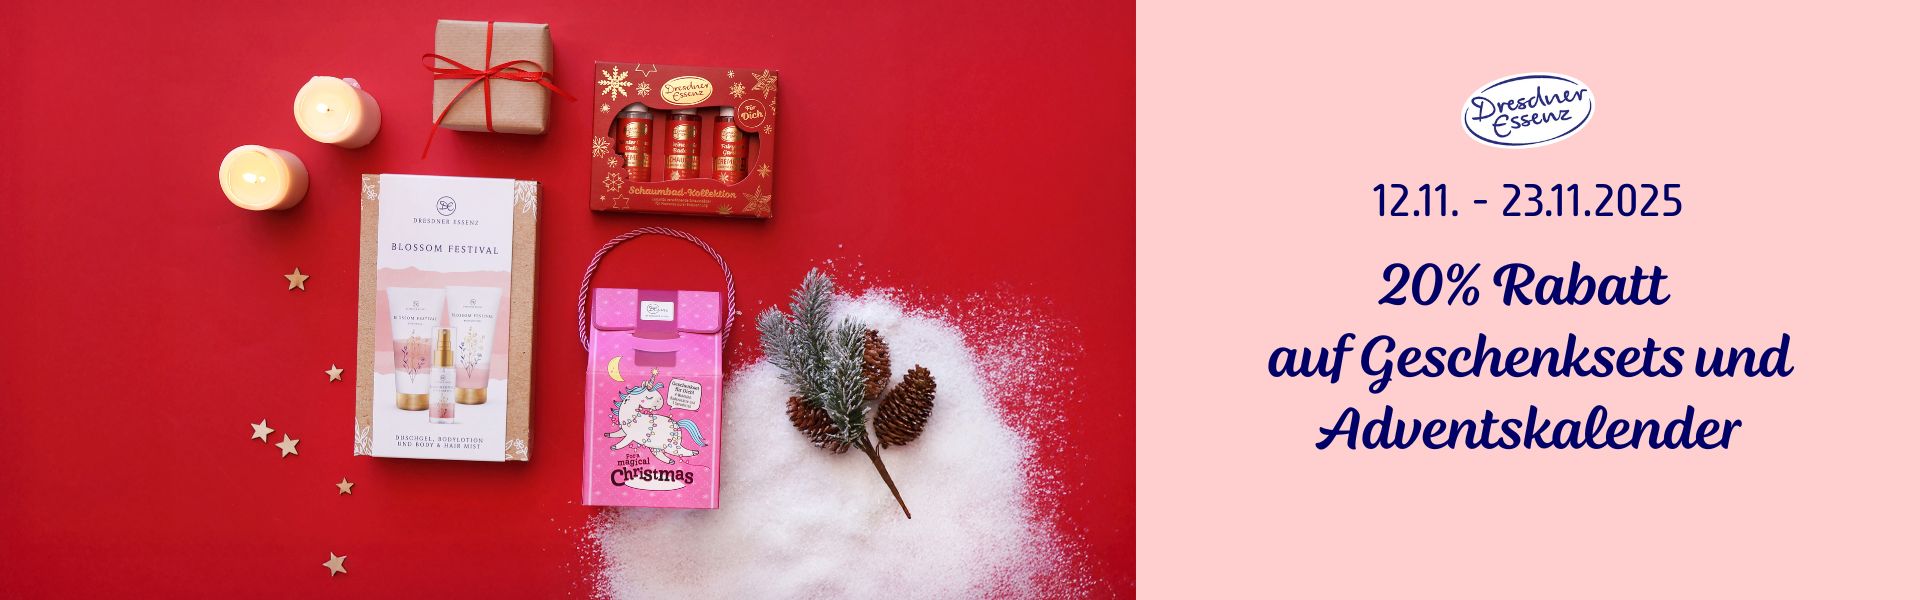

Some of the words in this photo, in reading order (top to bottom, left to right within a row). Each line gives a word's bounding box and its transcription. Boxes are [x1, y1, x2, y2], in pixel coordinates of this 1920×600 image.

[665, 82, 709, 94] Dresdner
[673, 90, 705, 101] Essenz
[741, 110, 763, 120] Dich
[628, 186, 737, 199] Schaumbad-Kollektion
[413, 217, 450, 225] DRESDNER
[391, 242, 443, 253] BLOSSOM
[448, 245, 499, 255] FESTIVAL
[617, 457, 650, 467] magical
[610, 467, 694, 486] Christmas
